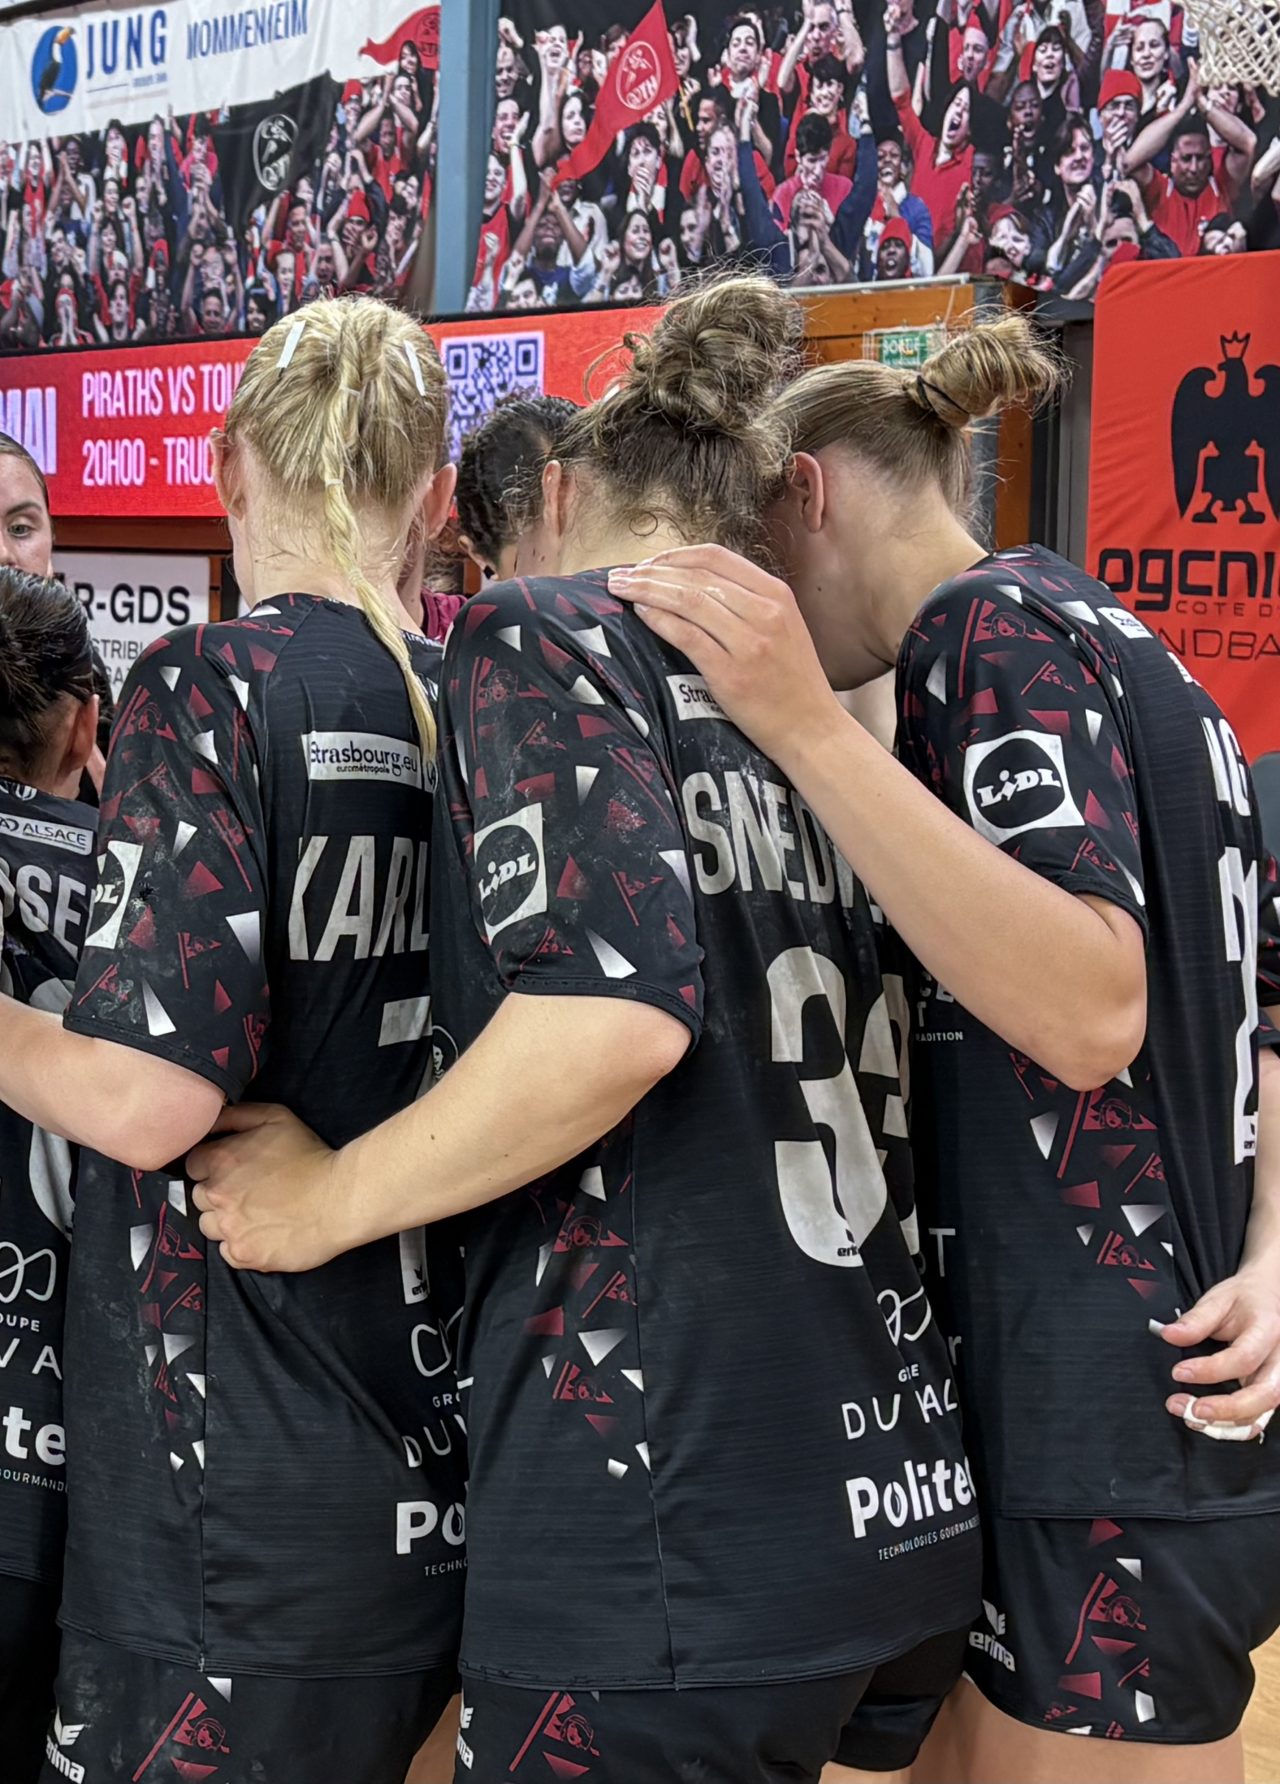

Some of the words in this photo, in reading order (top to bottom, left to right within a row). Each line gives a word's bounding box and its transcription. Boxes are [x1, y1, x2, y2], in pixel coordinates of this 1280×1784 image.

[86, 9, 168, 79] JUNG
[82, 367, 162, 418] PIRATHS
[168, 365, 196, 415] VS
[200, 361, 246, 413] TOU
[82, 438, 145, 487] 20H00
[1176, 601, 1245, 617] COTE
[90, 637, 144, 660] STRIB
[1158, 628, 1280, 661] NDBA
[23, 823, 87, 846] ALSACE
[288, 835, 430, 962] KARL
[915, 1031, 964, 1042] ADITION
[877, 1529, 938, 1561] TECHNOLOGIES
[969, 1631, 1016, 1673] erima
